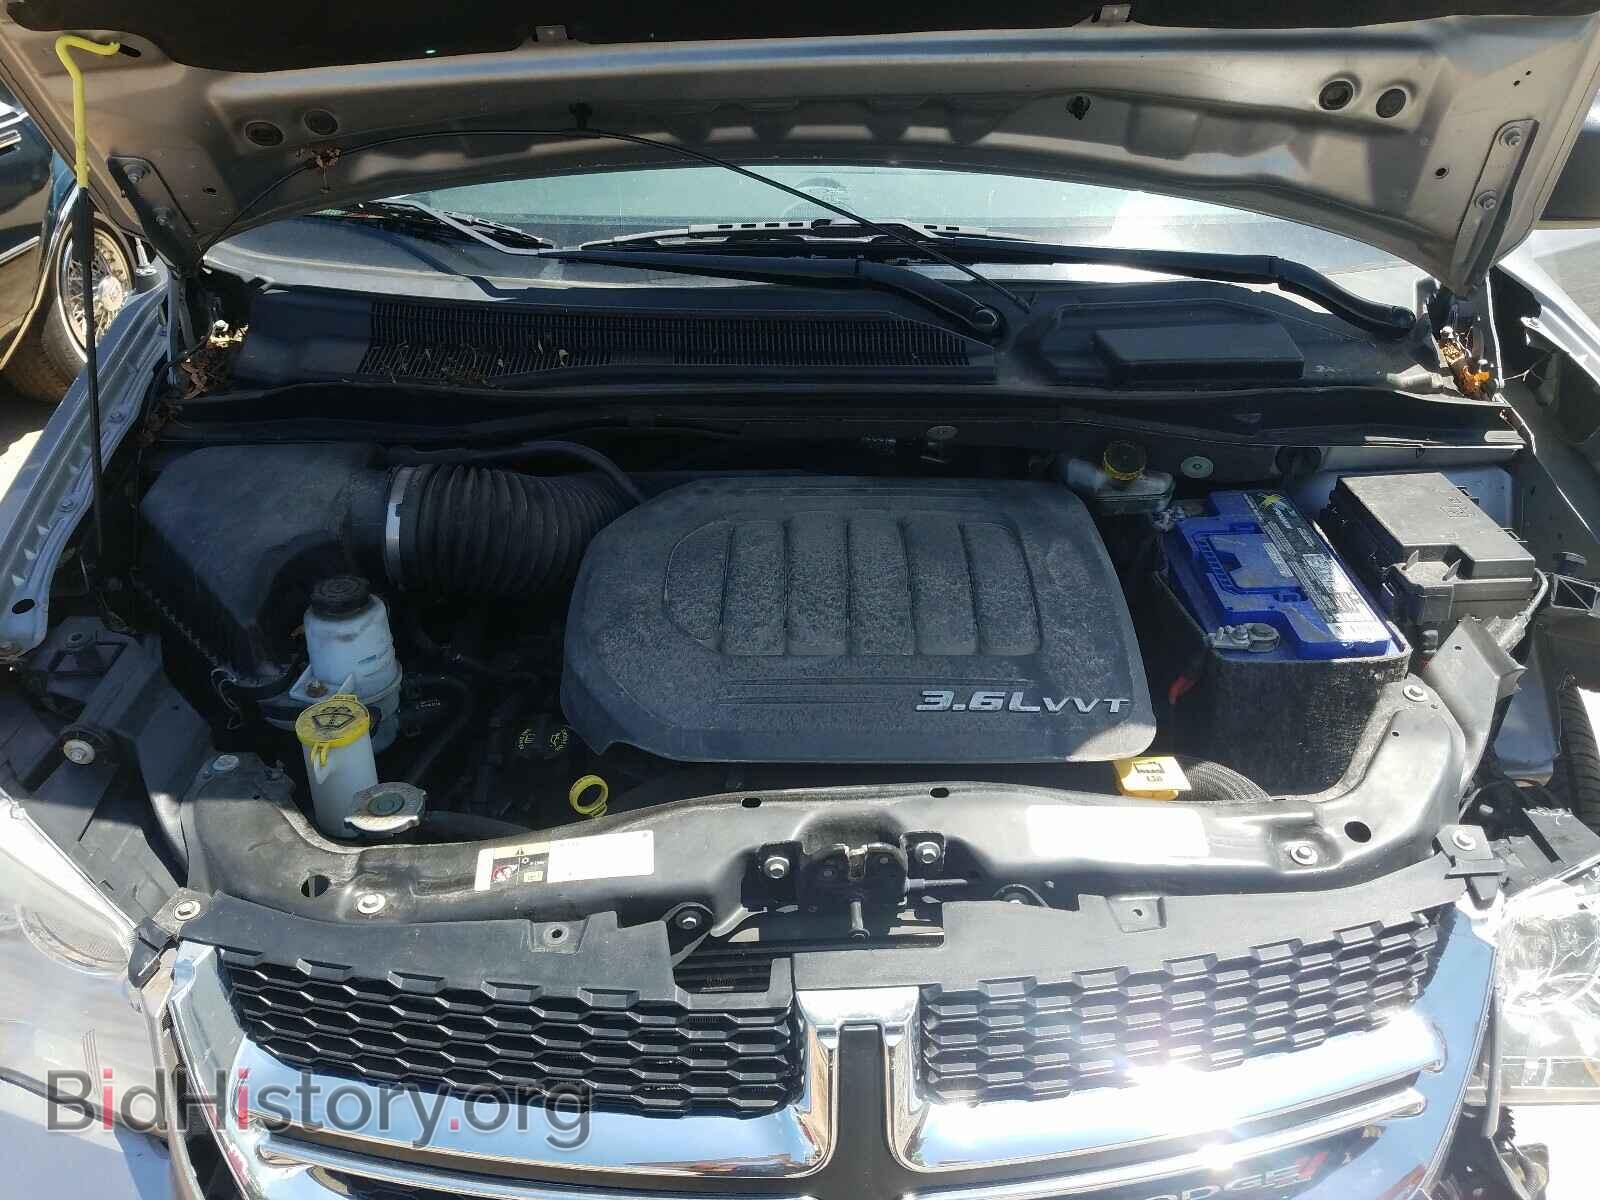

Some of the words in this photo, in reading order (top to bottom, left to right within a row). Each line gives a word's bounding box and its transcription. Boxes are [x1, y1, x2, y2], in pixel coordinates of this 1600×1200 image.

[915, 690, 1041, 712] 3.6L
[1042, 697, 1130, 713] VVT
[1144, 1165, 1312, 1200] ODGE
